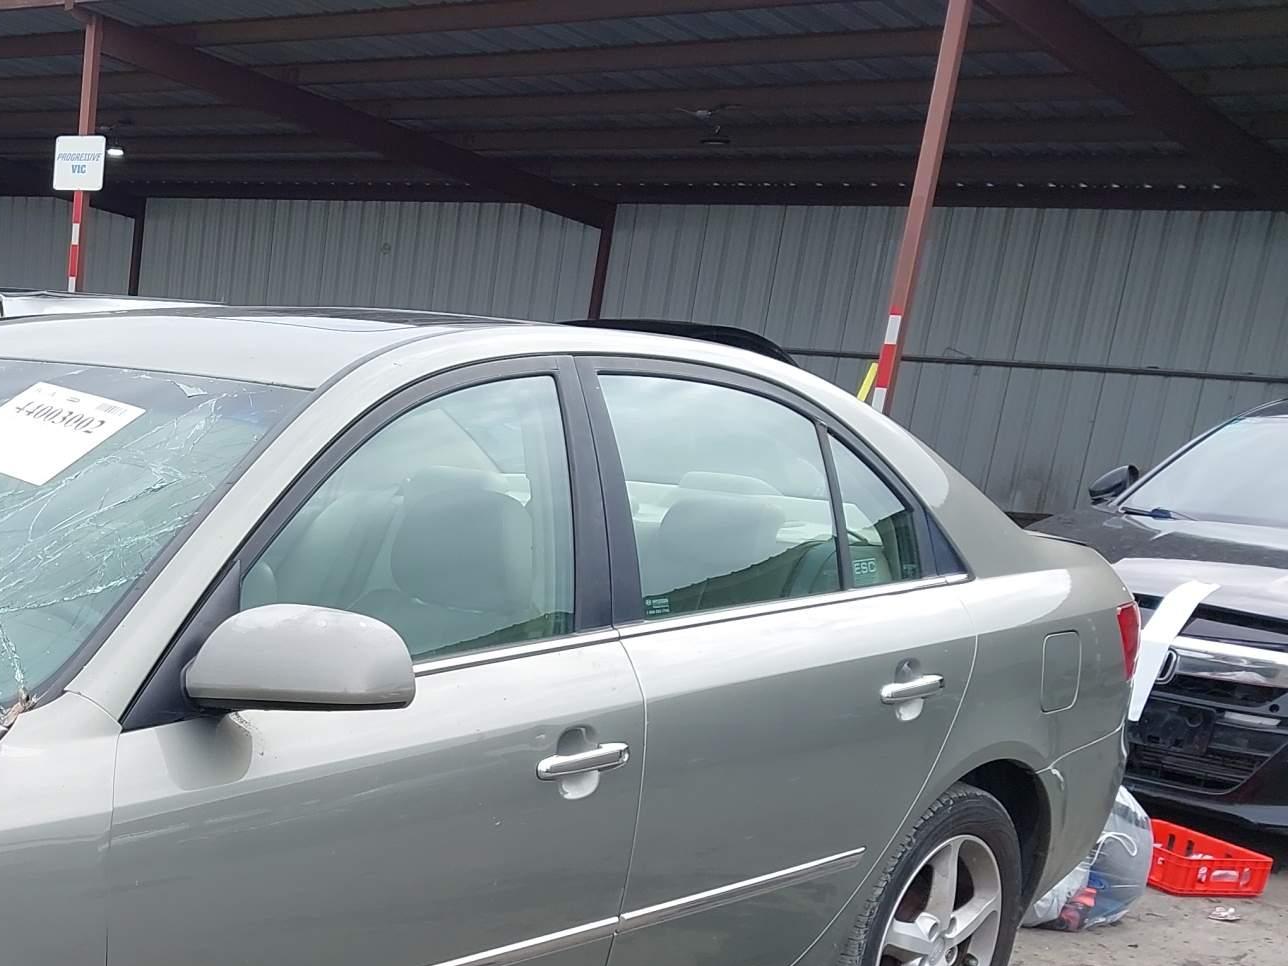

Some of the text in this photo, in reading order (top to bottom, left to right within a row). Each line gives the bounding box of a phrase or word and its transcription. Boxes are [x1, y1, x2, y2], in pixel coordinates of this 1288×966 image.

[57, 152, 102, 162] PROGRESSIVE
[71, 164, 87, 174] VIC
[15, 401, 106, 434] 44003002
[854, 561, 876, 575] ESC
